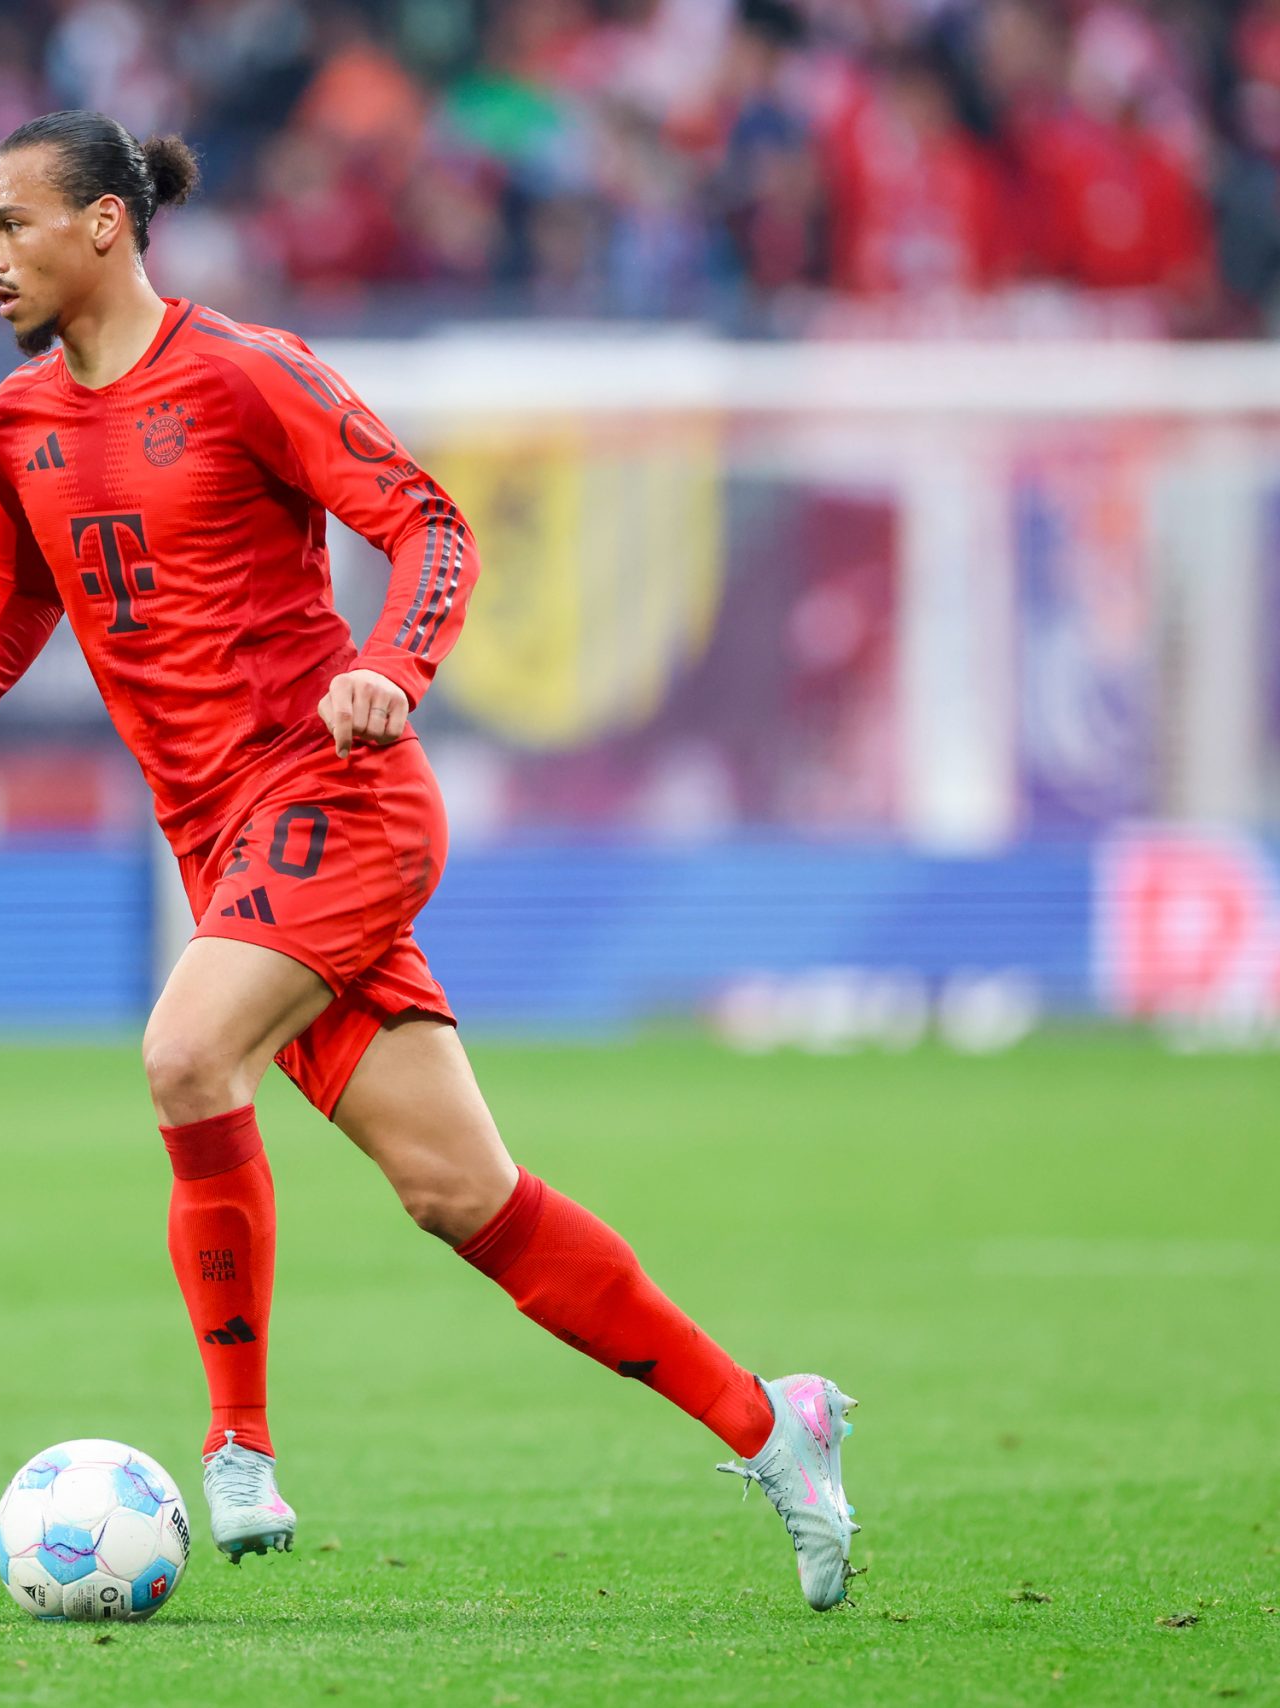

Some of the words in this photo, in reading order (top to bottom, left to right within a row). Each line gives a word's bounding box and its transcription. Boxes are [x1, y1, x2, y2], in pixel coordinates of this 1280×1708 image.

[156, 418, 183, 436] BAYERN
[70, 513, 156, 634] T
[199, 1249, 234, 1260] MIA
[201, 1260, 235, 1271] SAN
[202, 1270, 236, 1281] MIA
[38, 1584, 46, 1608] SELECT
